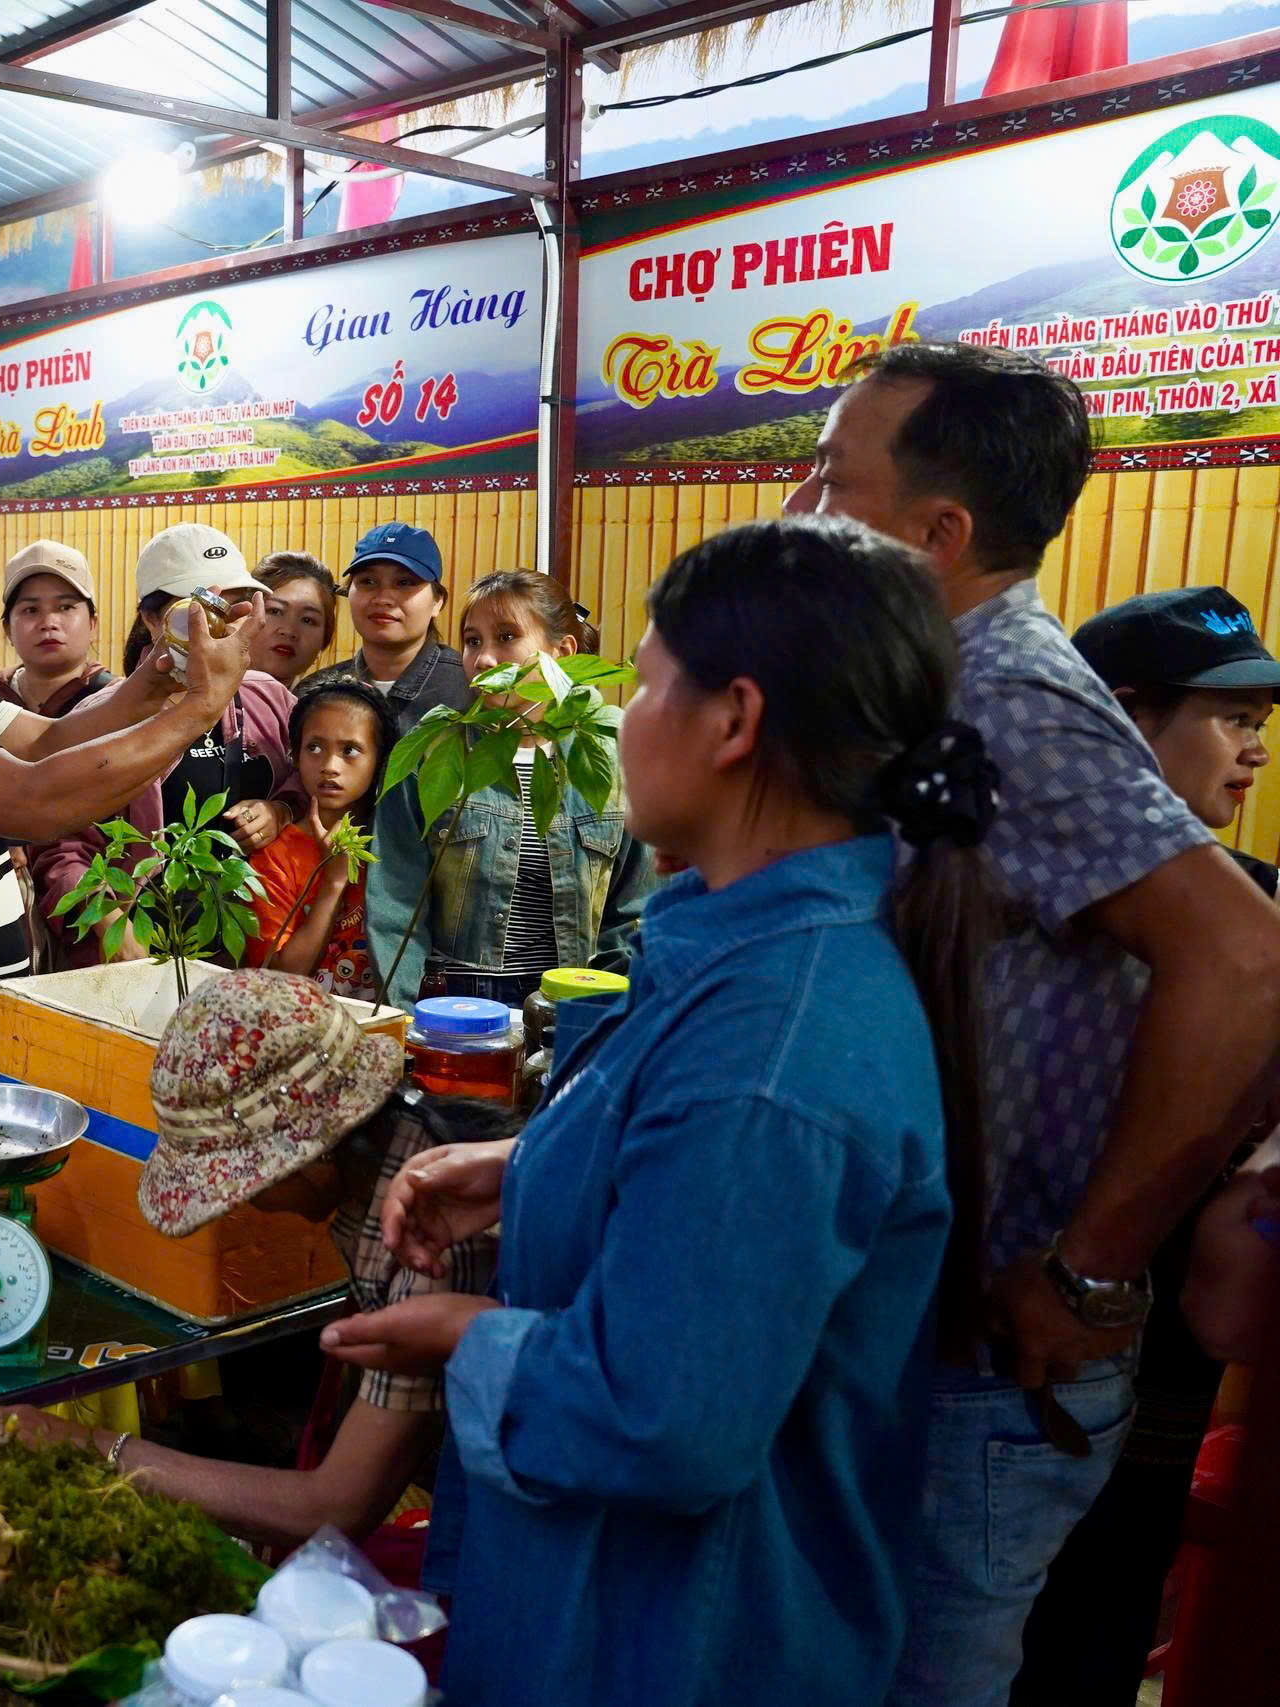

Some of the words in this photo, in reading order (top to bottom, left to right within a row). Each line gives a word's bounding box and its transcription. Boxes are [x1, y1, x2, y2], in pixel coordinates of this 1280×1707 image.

[629, 248, 722, 303] CHỢ
[731, 220, 894, 290] PHIÊN
[302, 304, 393, 356] Gian
[409, 285, 528, 331] Hàng
[1016, 327, 1039, 348] RA
[1045, 315, 1096, 344] HẰNG
[1102, 310, 1168, 339] THÁNG
[1175, 303, 1217, 332] VÀO
[1225, 294, 1272, 326] THỨ
[25, 348, 91, 389] PHIÊN
[607, 337, 715, 400] Trà
[1102, 346, 1142, 377] ĐẦU
[1148, 343, 1194, 373] TIÊN
[1201, 337, 1245, 368] CỦA
[1253, 338, 1280, 363] TH
[357, 359, 404, 426] SỐ
[416, 373, 458, 421] 14
[1112, 389, 1152, 416] PIN,
[1159, 380, 1214, 410] THÔN
[1221, 383, 1241, 409] 2,
[1248, 375, 1278, 404] XÃ
[31, 403, 102, 451] Linh
